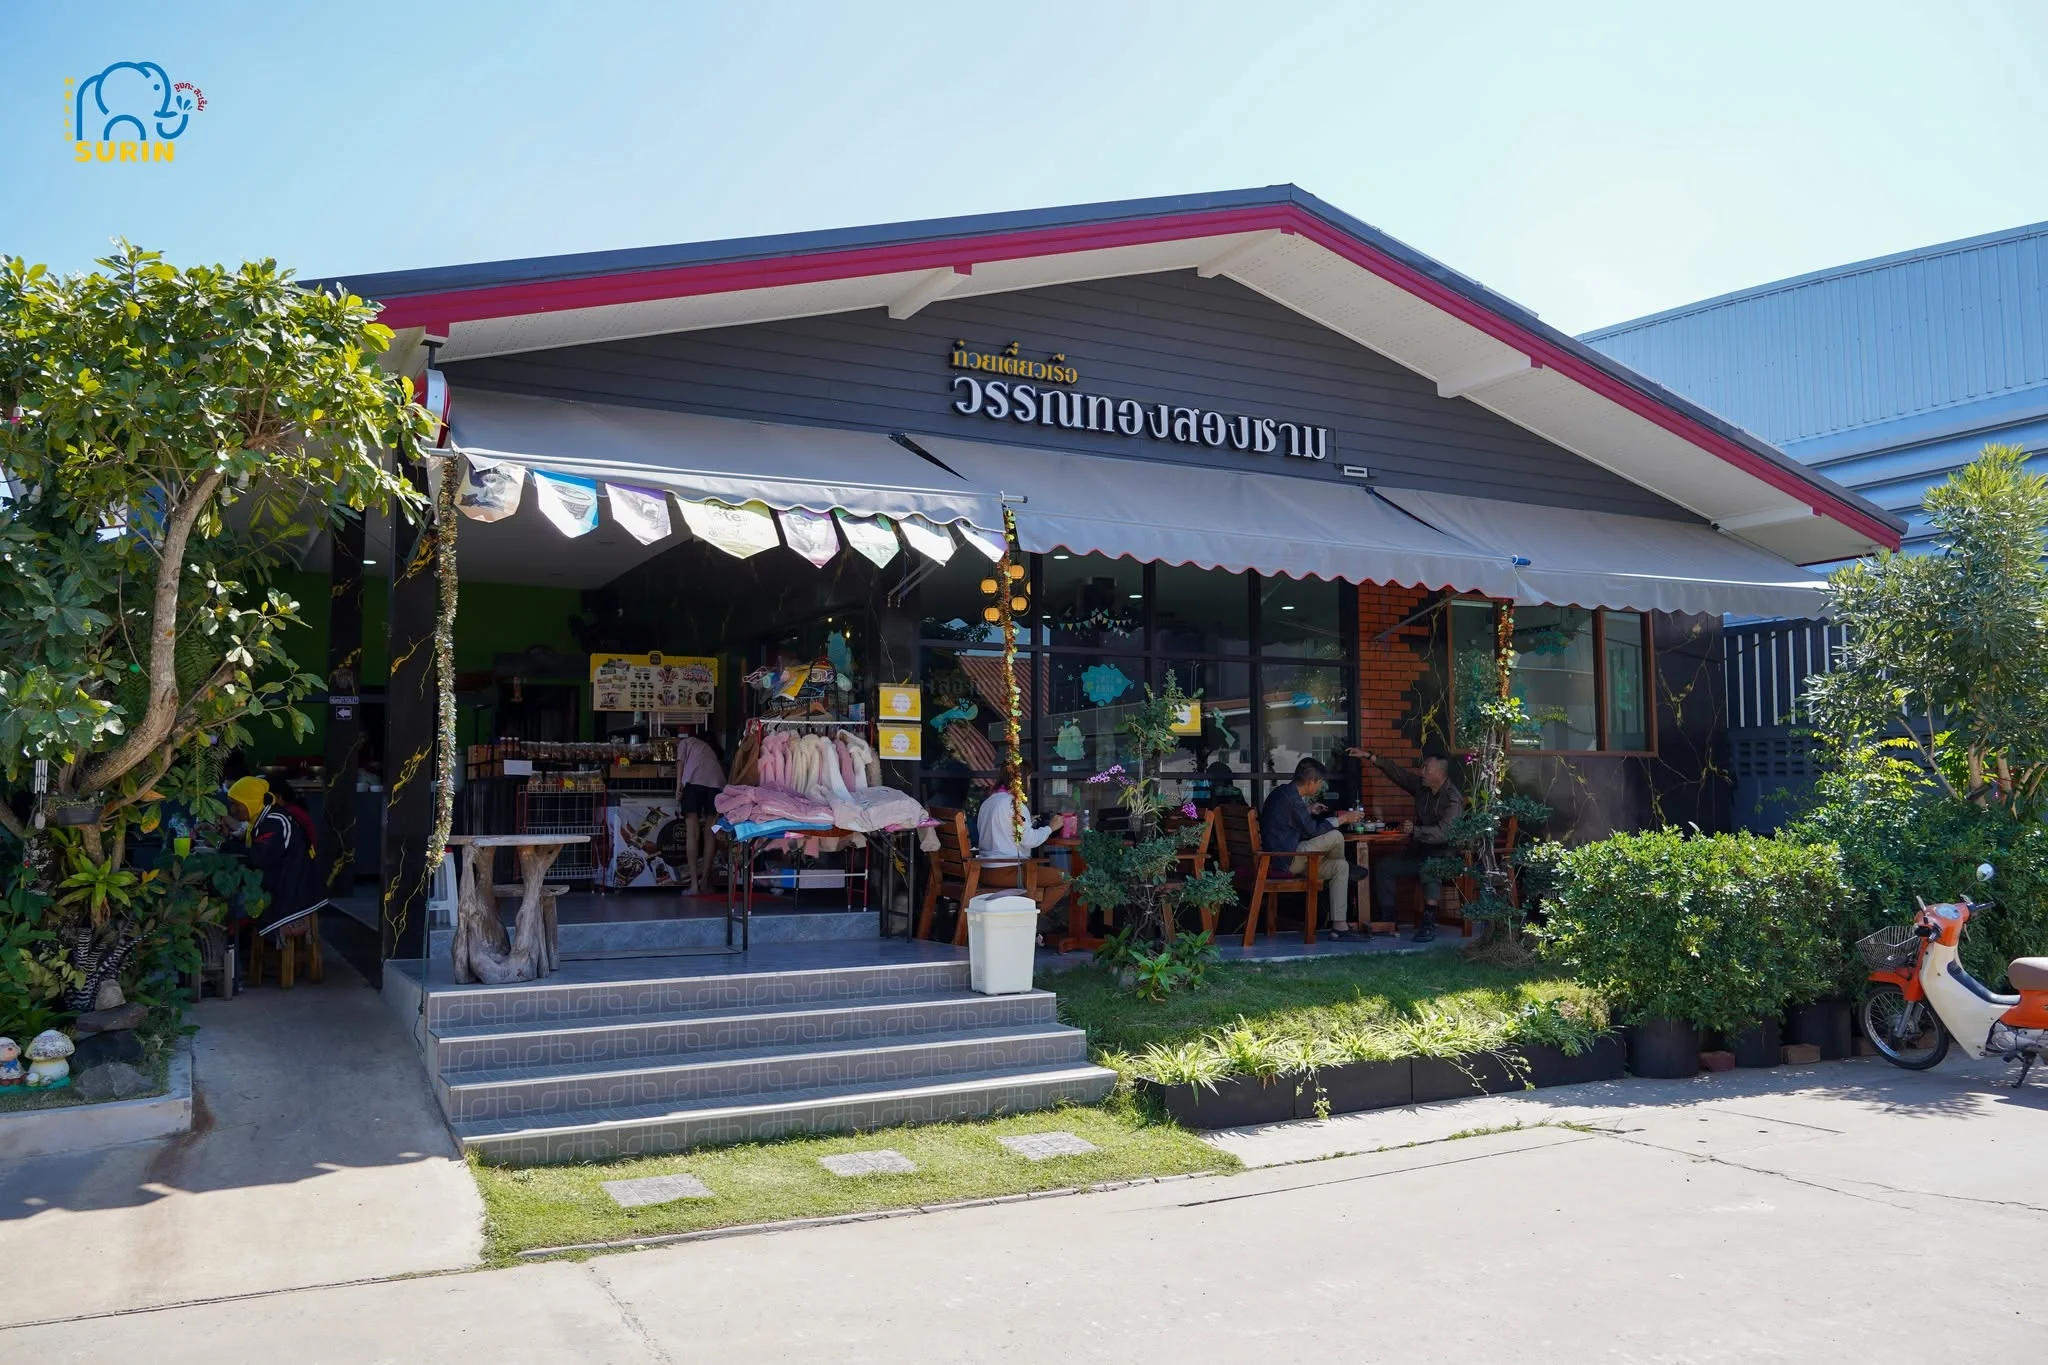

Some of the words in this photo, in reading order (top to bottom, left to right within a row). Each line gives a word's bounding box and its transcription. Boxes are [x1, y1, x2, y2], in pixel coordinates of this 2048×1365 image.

[953, 376, 1328, 460] วรรณทองสองชาม
